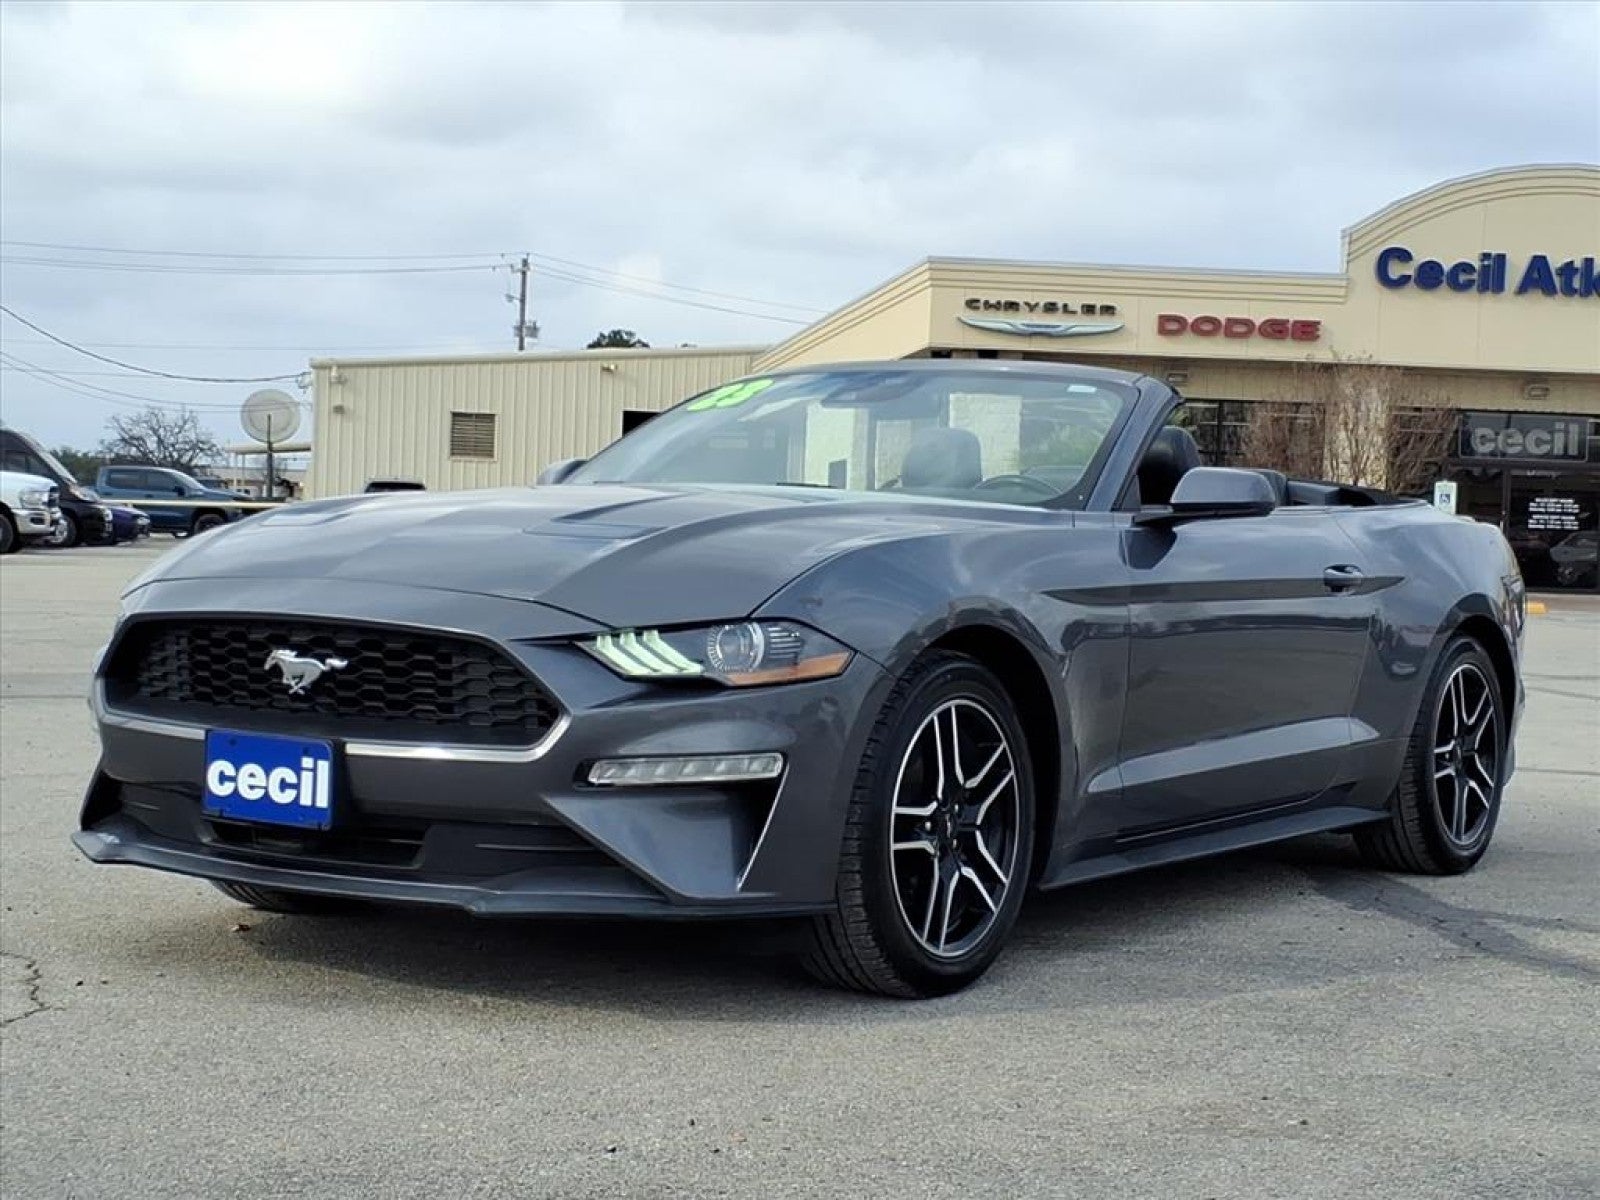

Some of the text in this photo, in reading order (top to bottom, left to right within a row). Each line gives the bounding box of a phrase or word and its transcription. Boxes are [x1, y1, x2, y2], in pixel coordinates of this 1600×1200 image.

[1376, 247, 1507, 294] Cecil
[965, 298, 1117, 315] CHRYSLER
[1157, 314, 1321, 341] DODGE
[1471, 421, 1579, 456] cecil
[207, 756, 330, 809] cecil
